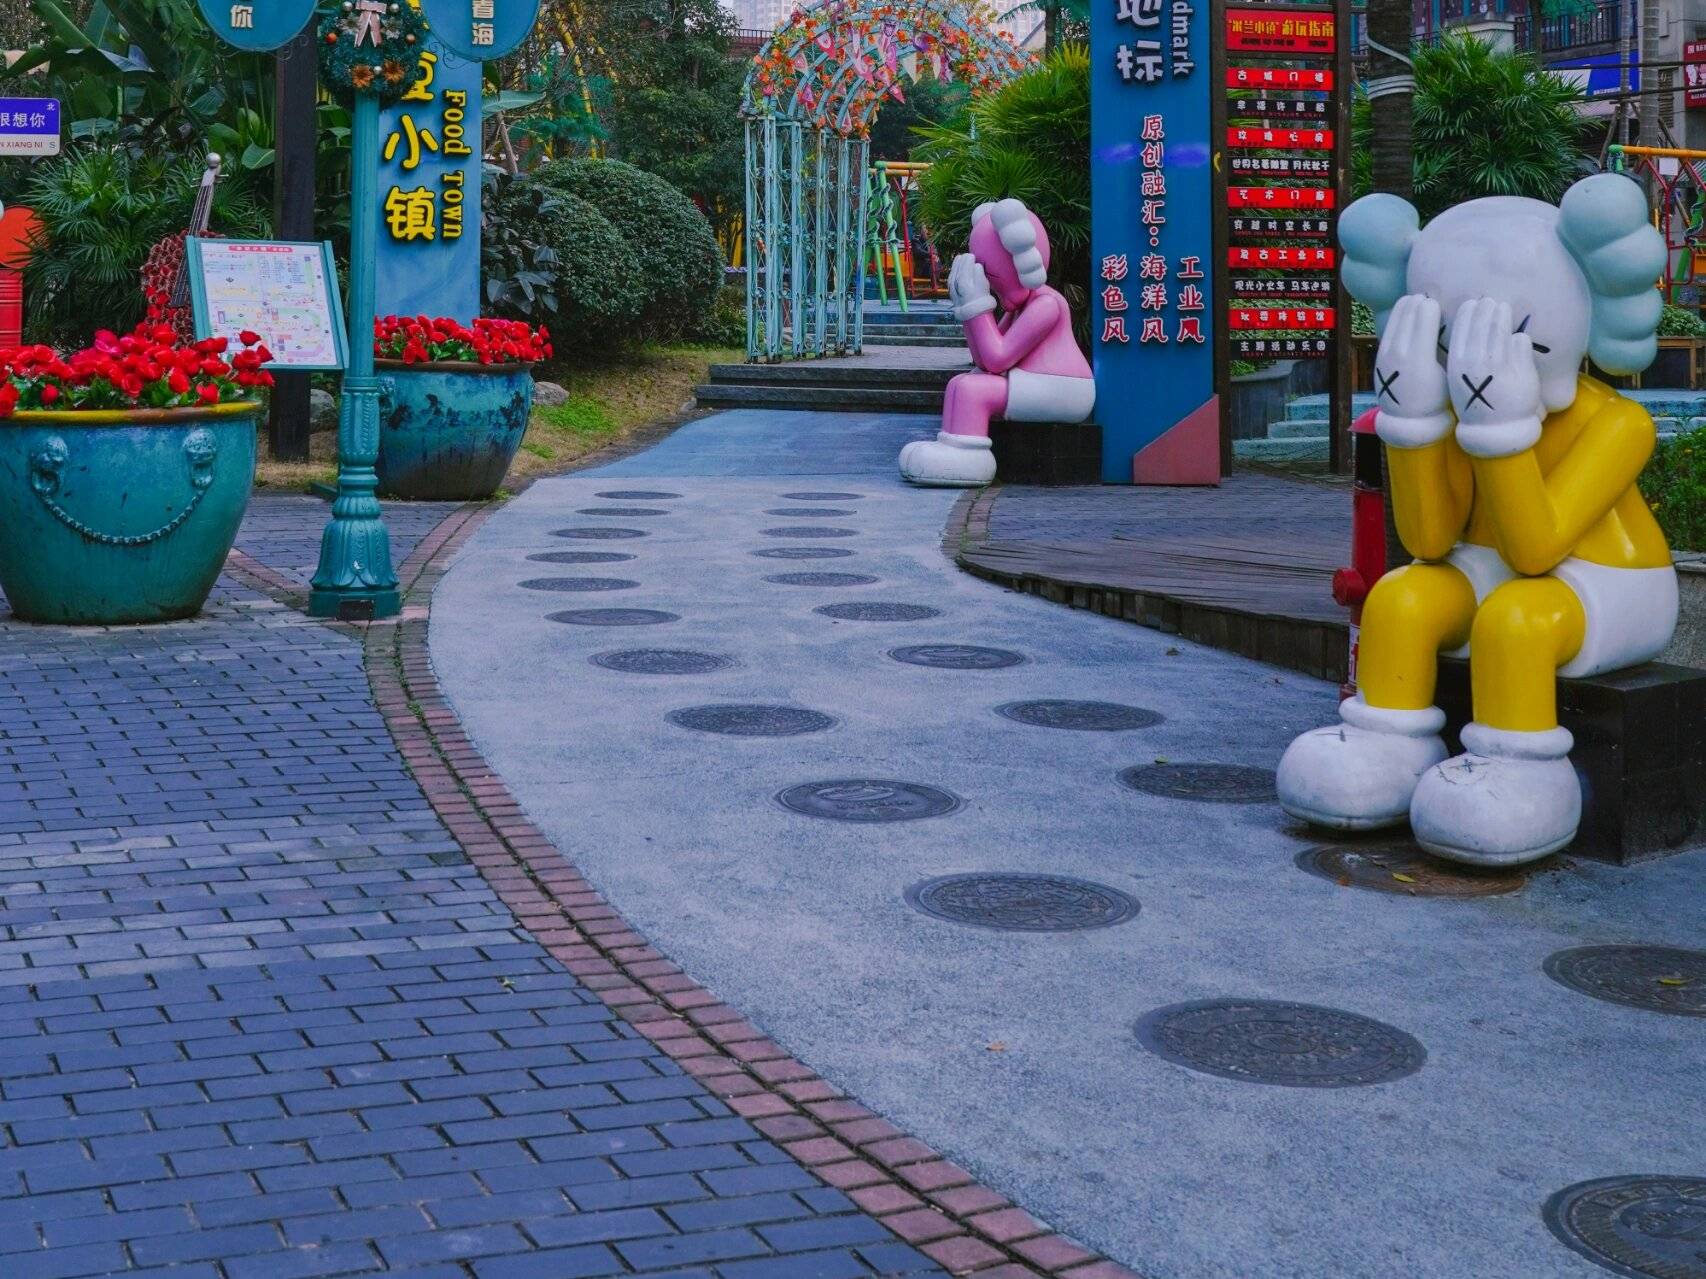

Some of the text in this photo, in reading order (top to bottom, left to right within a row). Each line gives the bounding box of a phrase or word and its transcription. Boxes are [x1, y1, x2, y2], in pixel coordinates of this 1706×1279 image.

[46, 102, 56, 111] 北
[49, 141, 56, 149] S
[442, 90, 472, 238] Food Town
[1101, 254, 1129, 343] 彩色风
[1140, 255, 1168, 343] 海洋风
[1176, 256, 1205, 343] 工业风
